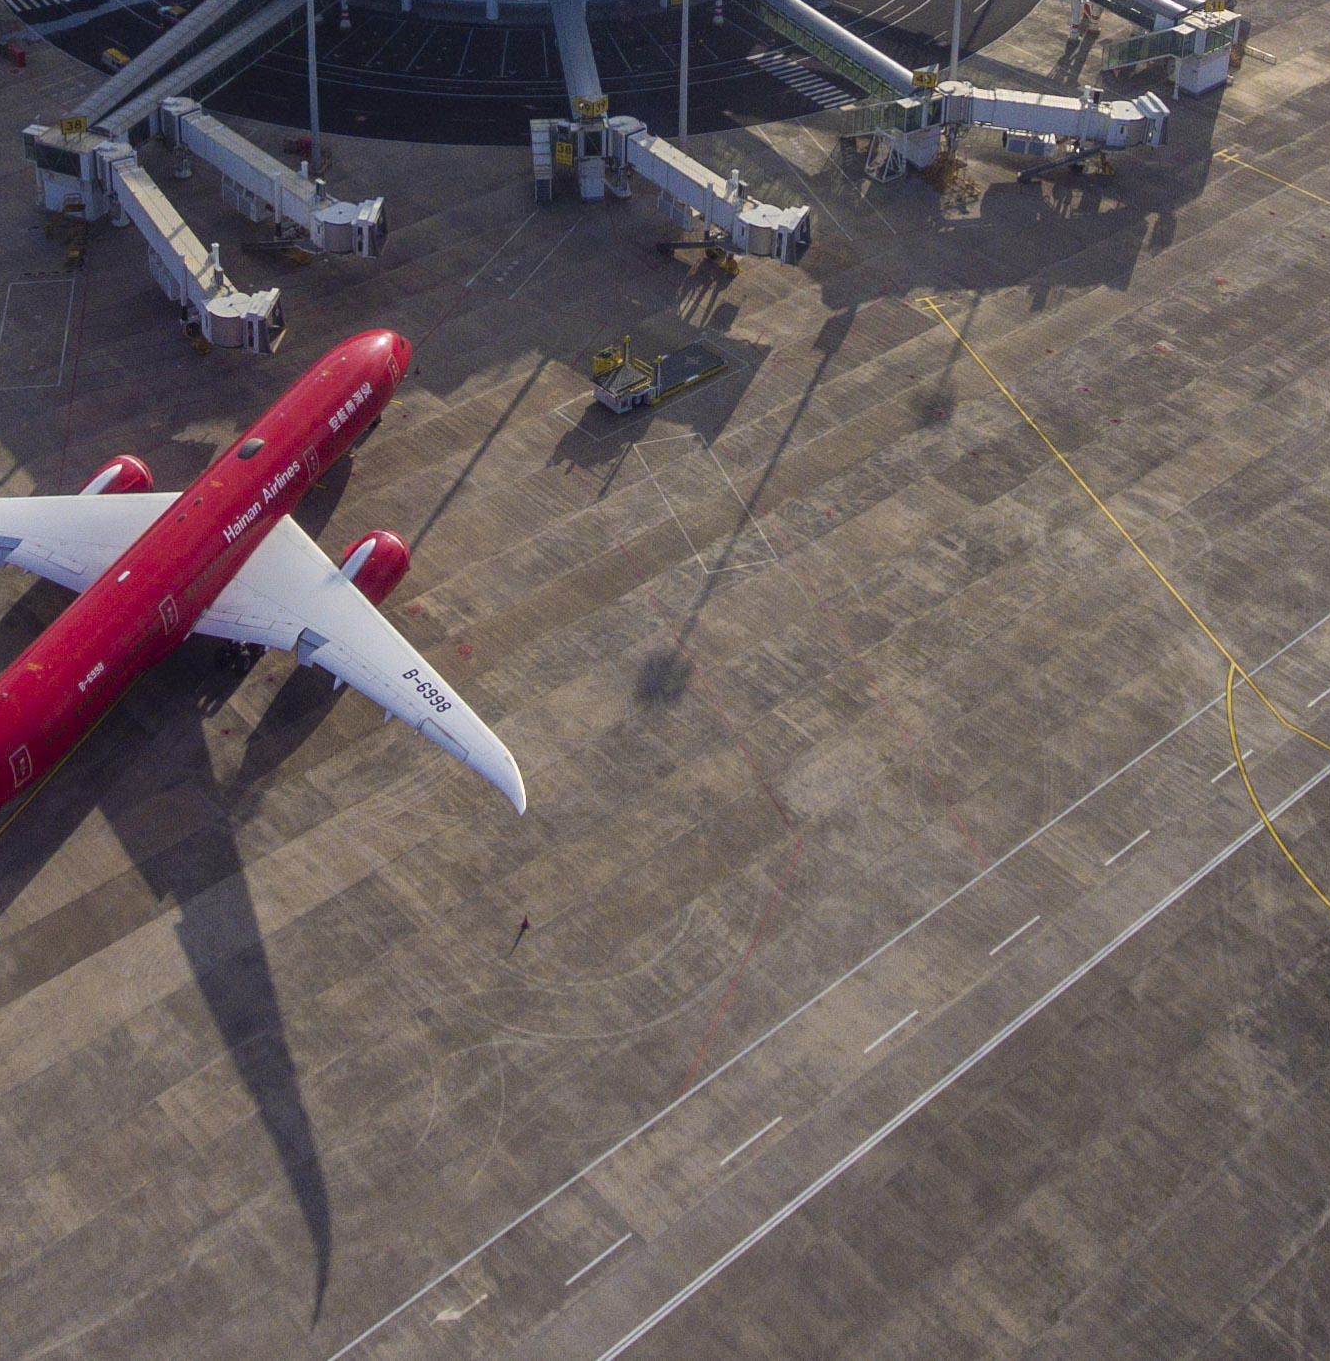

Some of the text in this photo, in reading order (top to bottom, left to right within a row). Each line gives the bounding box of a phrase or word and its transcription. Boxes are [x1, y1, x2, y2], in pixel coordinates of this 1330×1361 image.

[65, 119, 82, 131] 38
[222, 460, 301, 544] Hainan Airlines
[402, 668, 452, 713] B-6998
